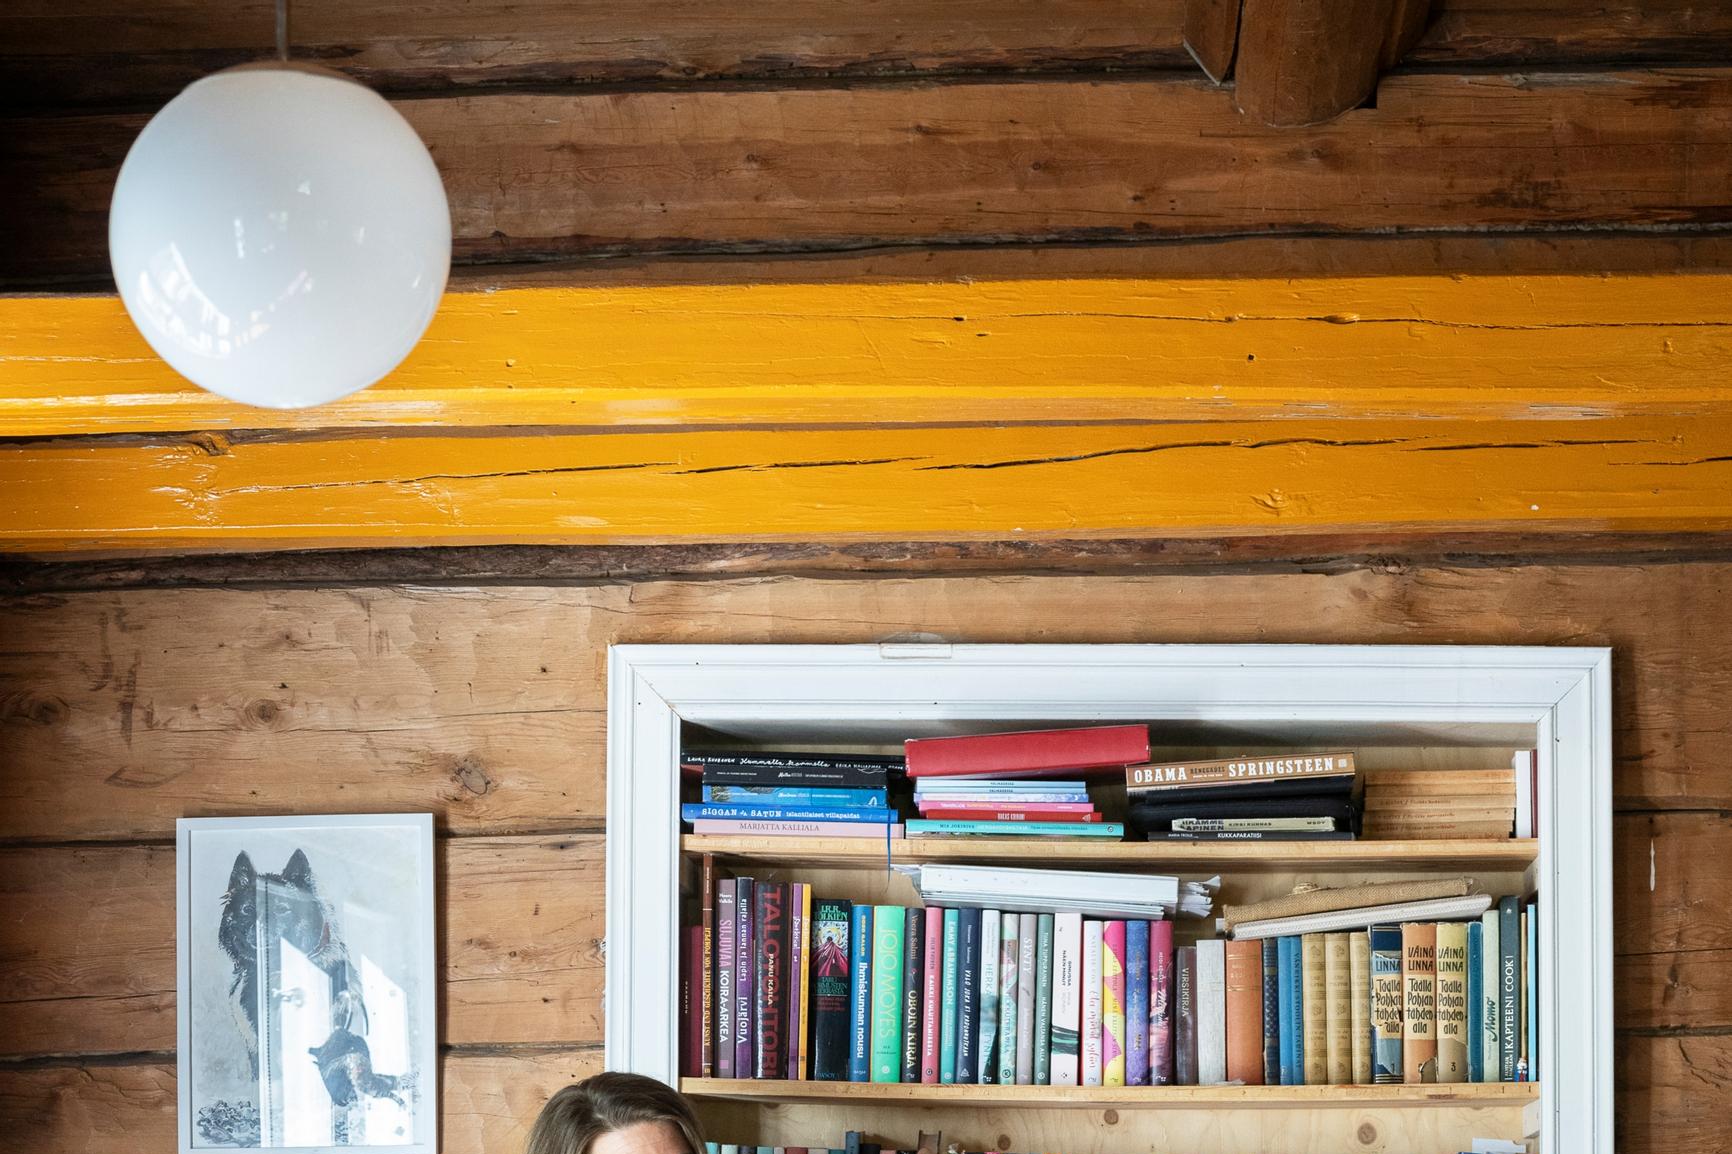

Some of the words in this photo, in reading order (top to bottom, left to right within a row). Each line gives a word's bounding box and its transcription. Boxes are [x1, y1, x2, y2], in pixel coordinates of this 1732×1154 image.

[1134, 767, 1188, 783] OBAMA
[1228, 757, 1334, 778] SPRINGSTEEN
[702, 808, 737, 817] SIGGAN
[750, 810, 783, 818] SATUN
[739, 823, 780, 833] MARJATTA
[782, 824, 820, 832] KALLIALA
[739, 898, 748, 922] rajalla
[910, 915, 918, 936] Veera
[947, 921, 956, 944] EMMY
[719, 920, 732, 968] SUJUVAA
[879, 929, 898, 970] JOJO
[910, 937, 918, 960] Salmi
[1022, 936, 1032, 974] SYNTY
[1408, 946, 1434, 958] VÄINÖ
[1438, 947, 1464, 959] VÄINÖ
[739, 961, 748, 981] Lapin
[767, 953, 775, 977] PANU
[946, 947, 955, 1005] ABRAHAMSON
[1376, 961, 1401, 972] LINNA
[1408, 960, 1433, 971] LINNA
[1438, 961, 1464, 972] LINNA
[1504, 960, 1514, 992] COOK
[763, 887, 781, 1076] TALOTOHTORI
[857, 962, 868, 1025] Ihmiskunnan
[1181, 967, 1189, 1017] VIRSIKIRJA
[719, 970, 730, 1043] KOIRA-ARKEA
[879, 974, 898, 1039] MOYES
[1408, 991, 1434, 1007] Pohjan
[1438, 993, 1464, 1008] Pohjan
[737, 997, 749, 1044] Vuojärvi
[1412, 1022, 1427, 1034] alla
[1443, 1023, 1458, 1035] alla
[1485, 996, 1498, 1042] Momo
[1504, 996, 1514, 1049] KAPTEENI
[857, 1027, 865, 1058] nousu
[906, 1031, 916, 1069] KIRJA
[1451, 1062, 1456, 1072] 3
